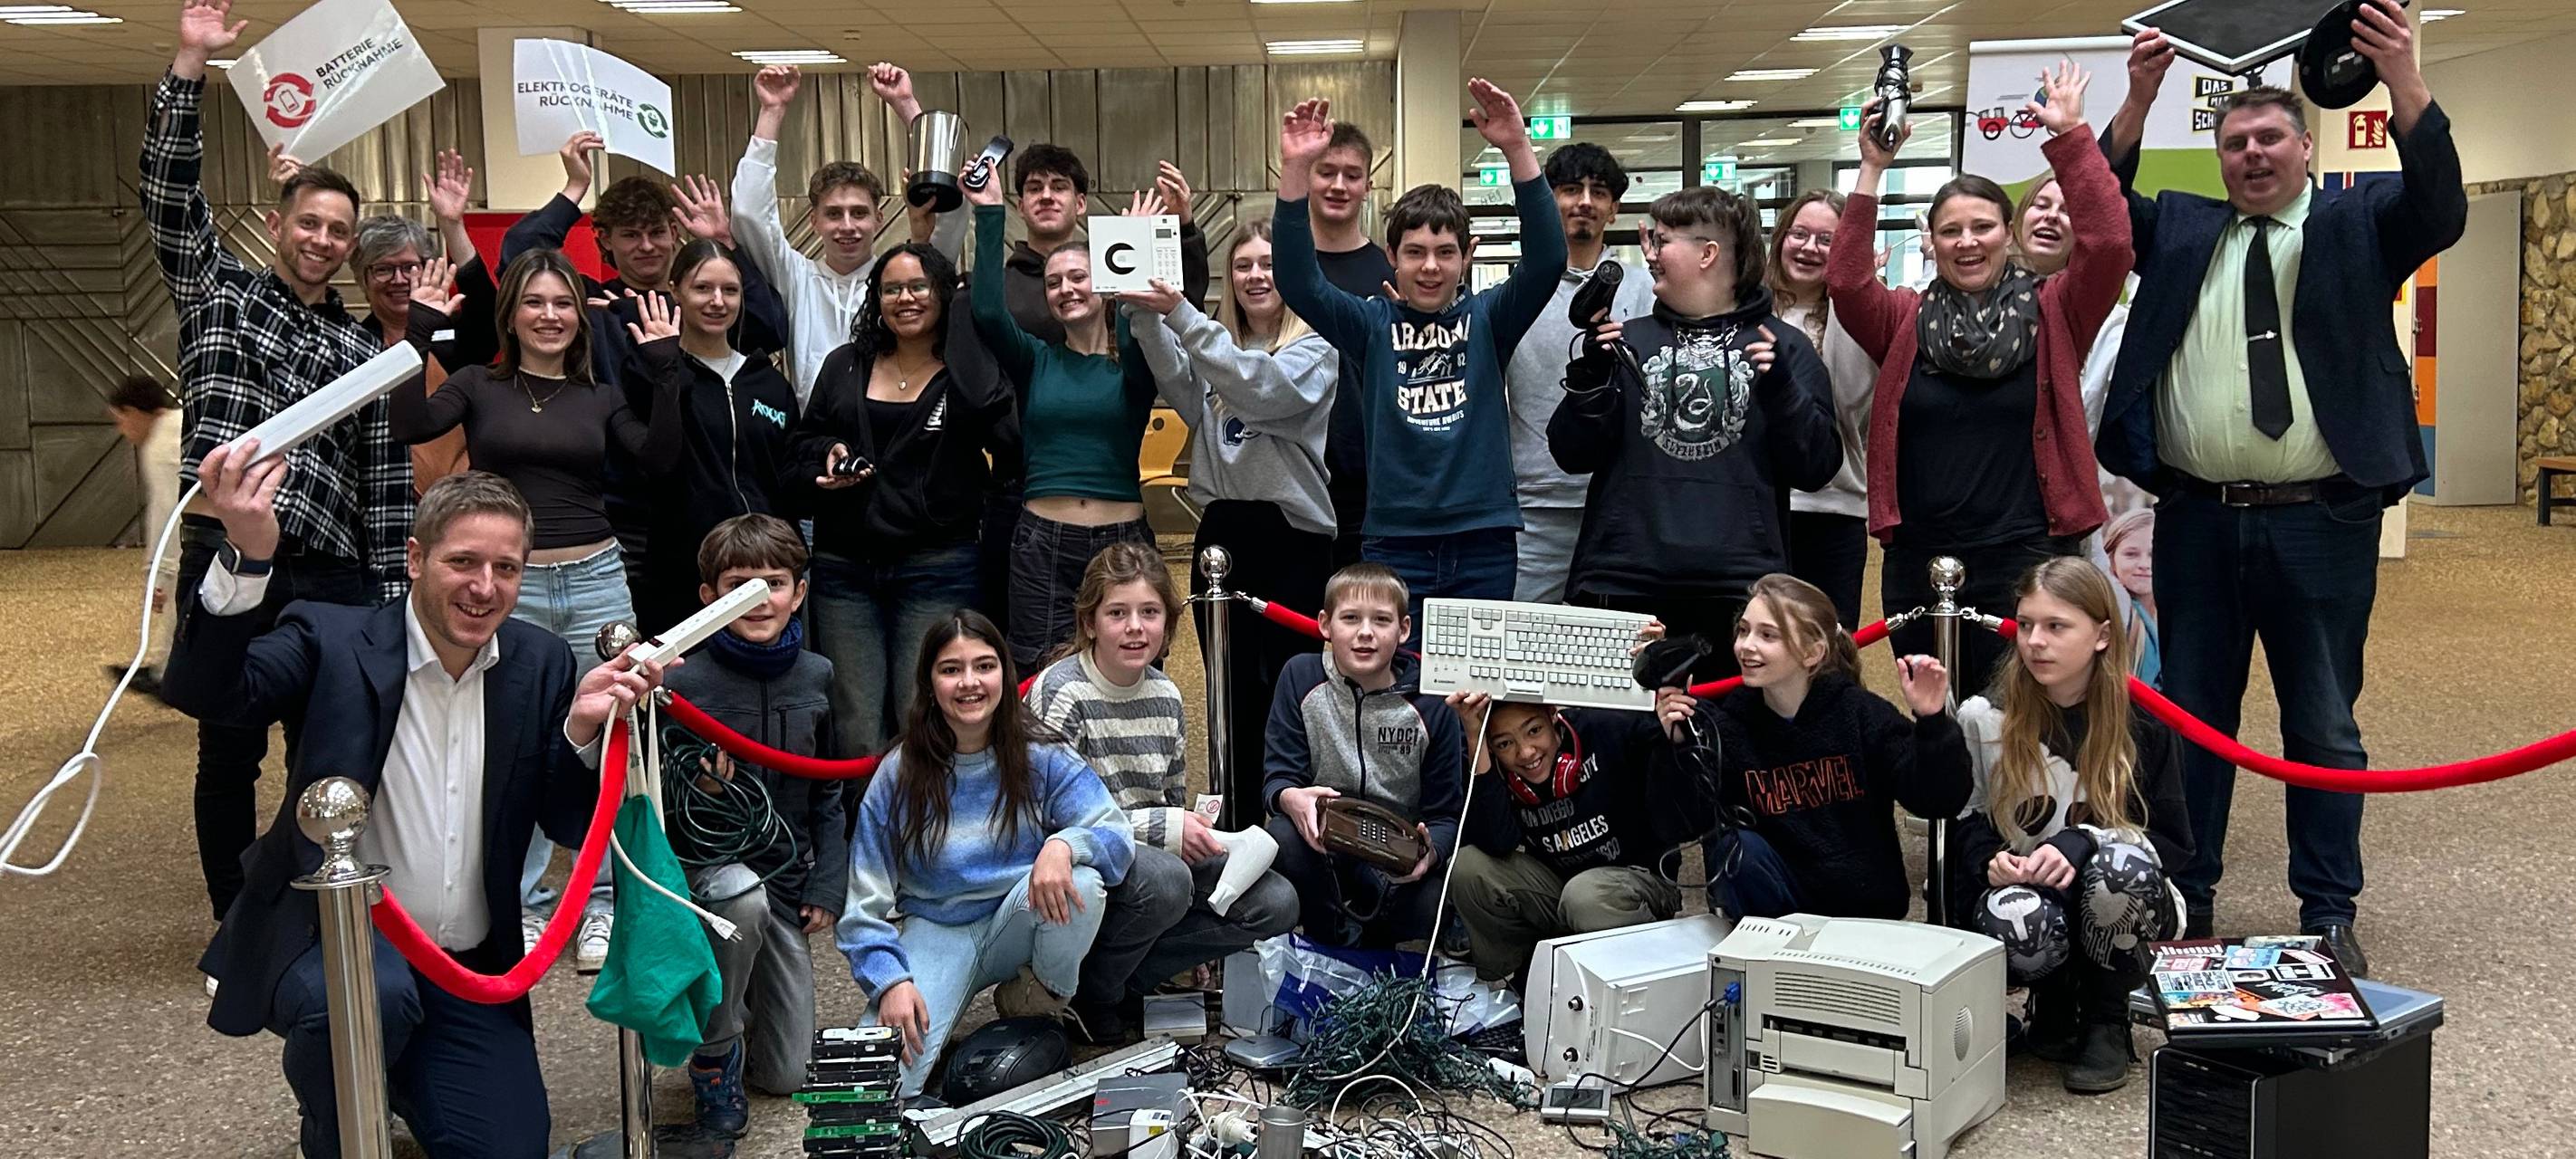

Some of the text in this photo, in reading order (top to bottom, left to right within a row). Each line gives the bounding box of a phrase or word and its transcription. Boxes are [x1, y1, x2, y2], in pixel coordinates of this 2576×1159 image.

[315, 38, 376, 78] BATTERIE
[322, 38, 404, 90] RÜCKNAHME
[2201, 79, 2228, 95] DAS
[2195, 111, 2216, 129] SCH
[1398, 360, 1407, 374] 19
[1397, 378, 1467, 415] STATE
[1745, 754, 1865, 815] MARVEL
[1537, 797, 1574, 826] DIEGO
[1553, 814, 1609, 852] ANGELES
